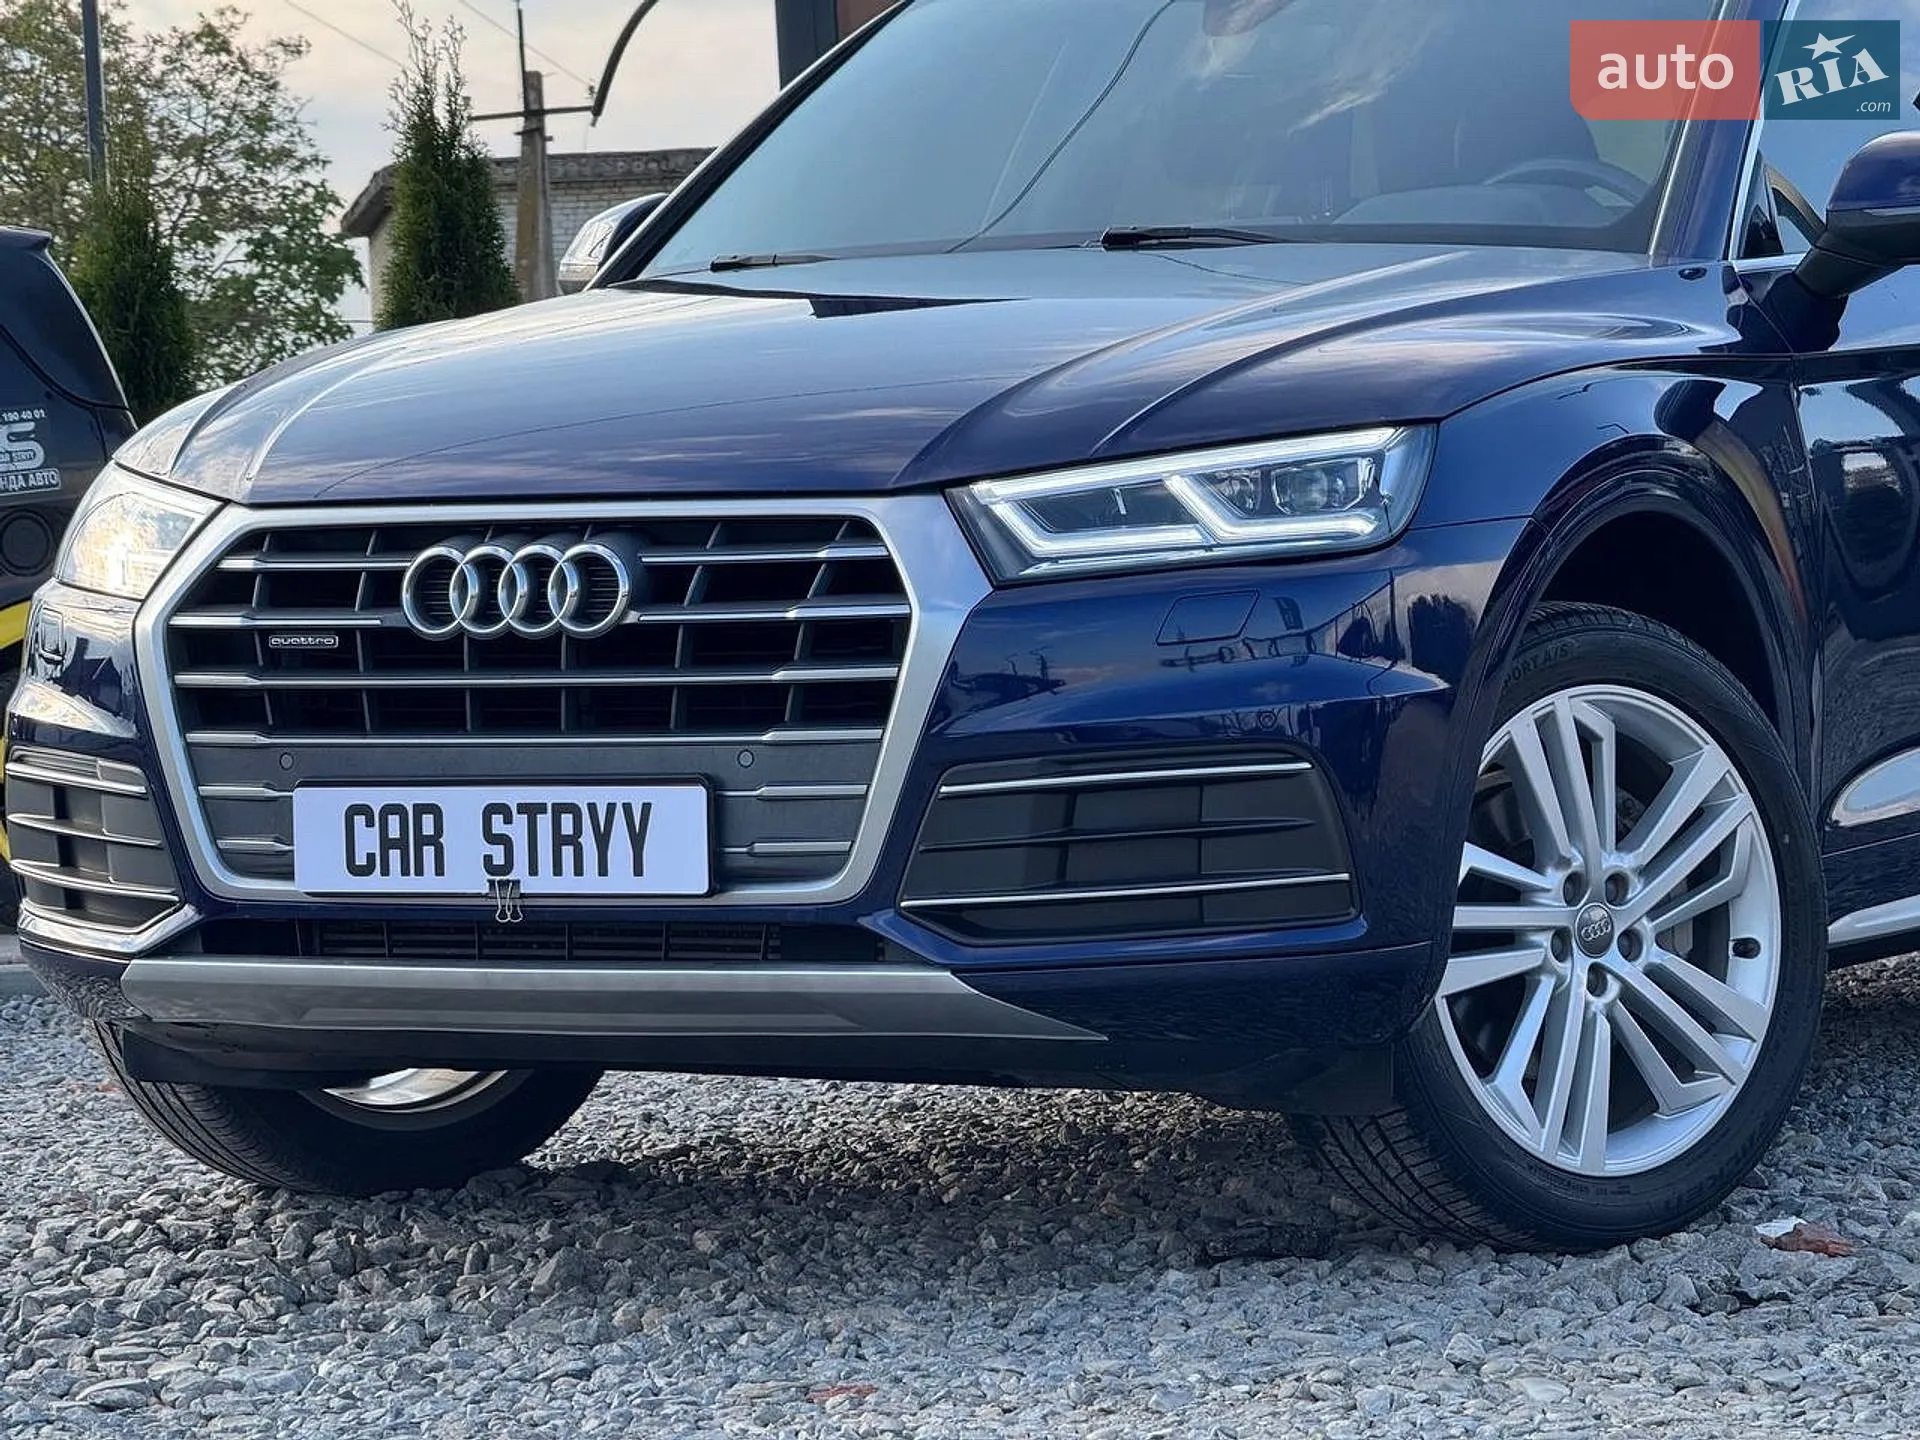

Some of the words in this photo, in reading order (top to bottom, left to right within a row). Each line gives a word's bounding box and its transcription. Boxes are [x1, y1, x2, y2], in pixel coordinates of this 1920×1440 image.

[28, 471, 57, 487] АВТО
[271, 636, 335, 645] quattro
[344, 802, 445, 877] CAR
[481, 802, 652, 877] STRYY
